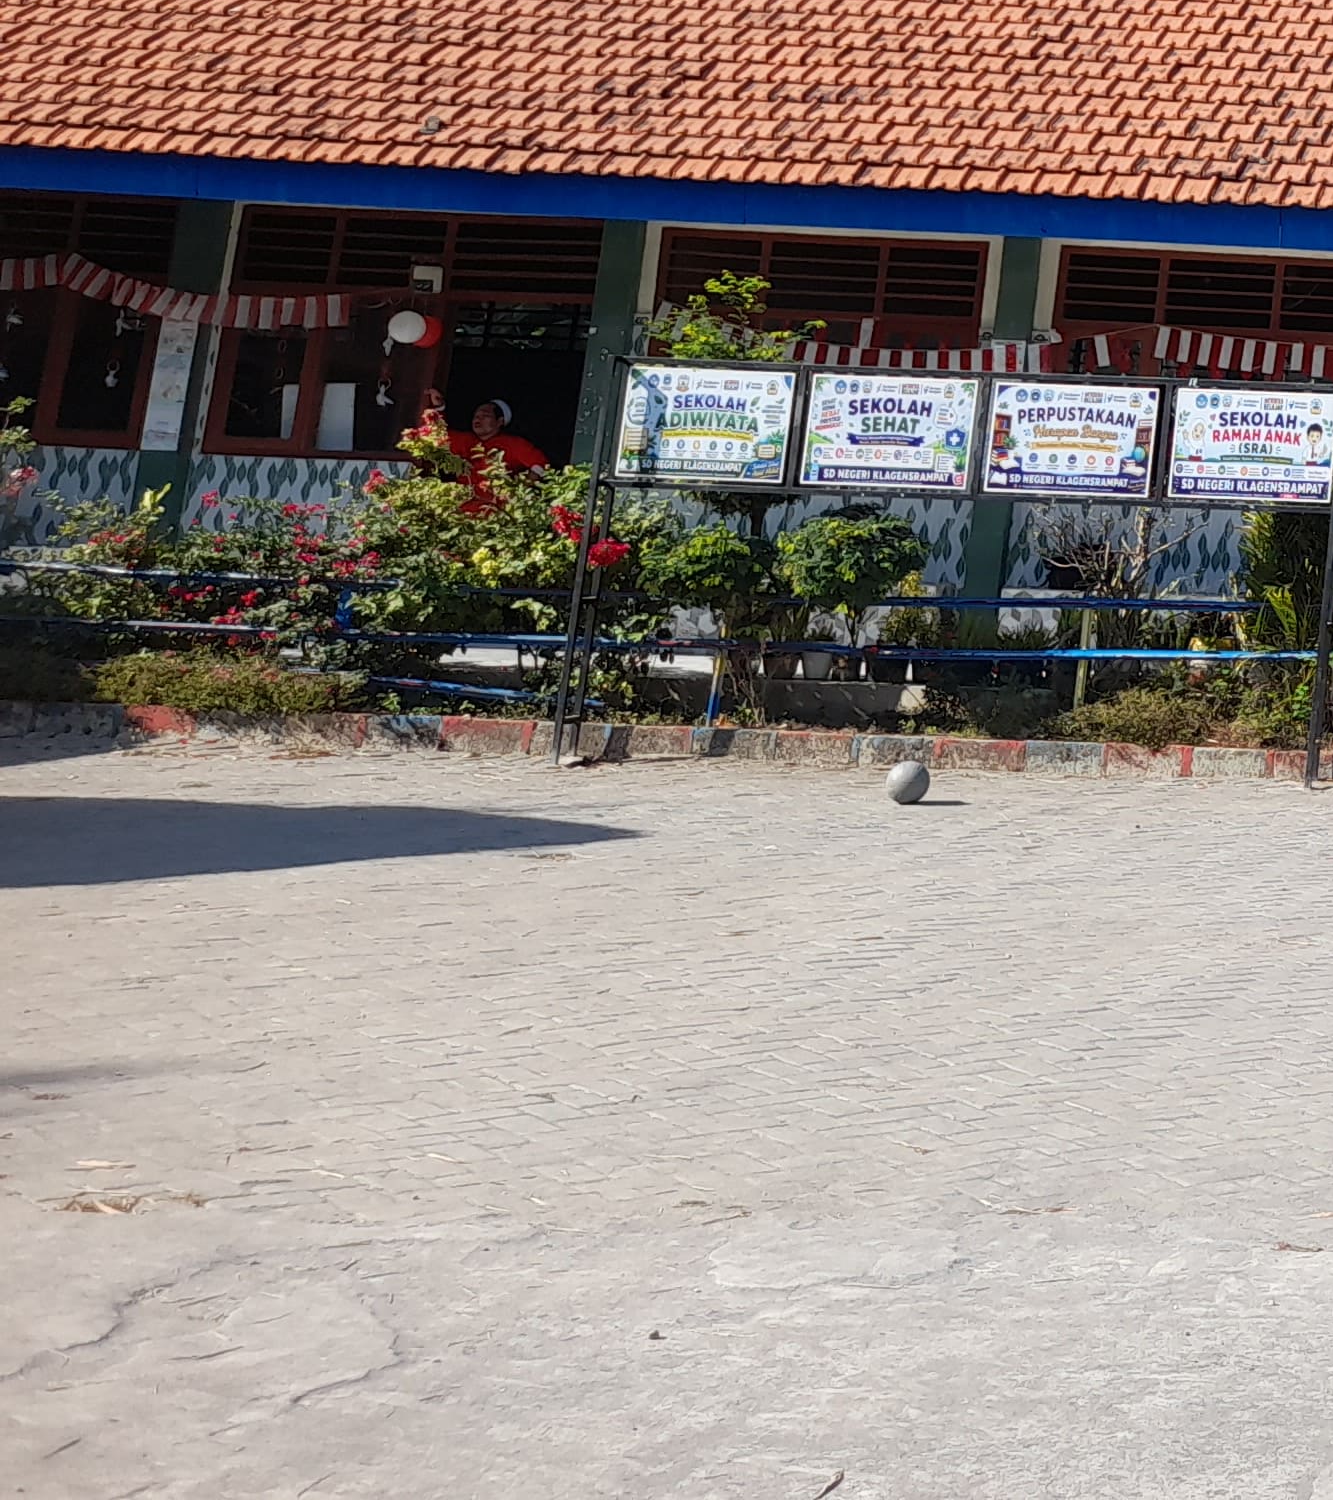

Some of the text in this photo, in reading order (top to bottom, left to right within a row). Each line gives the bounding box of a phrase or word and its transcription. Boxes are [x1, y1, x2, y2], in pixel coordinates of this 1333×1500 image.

[673, 394, 747, 411] SEKOLAH
[848, 398, 932, 417] SEKOLAH
[656, 411, 758, 432] ADIWIYATA
[861, 416, 920, 434] SEHAT
[1018, 407, 1137, 429] PERPUSTAKAAN
[1219, 412, 1297, 429] SEKOLAH
[1212, 429, 1302, 446] RAMAH ANAK
[1238, 443, 1273, 455] (SRA)
[642, 459, 652, 469] SD
[654, 460, 681, 470] NEGERI
[823, 468, 949, 482] SD NEGERI KLAGENSRAMPAT
[1009, 474, 1021, 483] SD
[1023, 474, 1054, 485] NEGERI
[1056, 475, 1129, 488] KLAGENSRAMPAT
[1181, 478, 1194, 490] SD
[1197, 479, 1234, 491] NEGERI
[1237, 481, 1324, 495] KLAGENSRAMPAT
